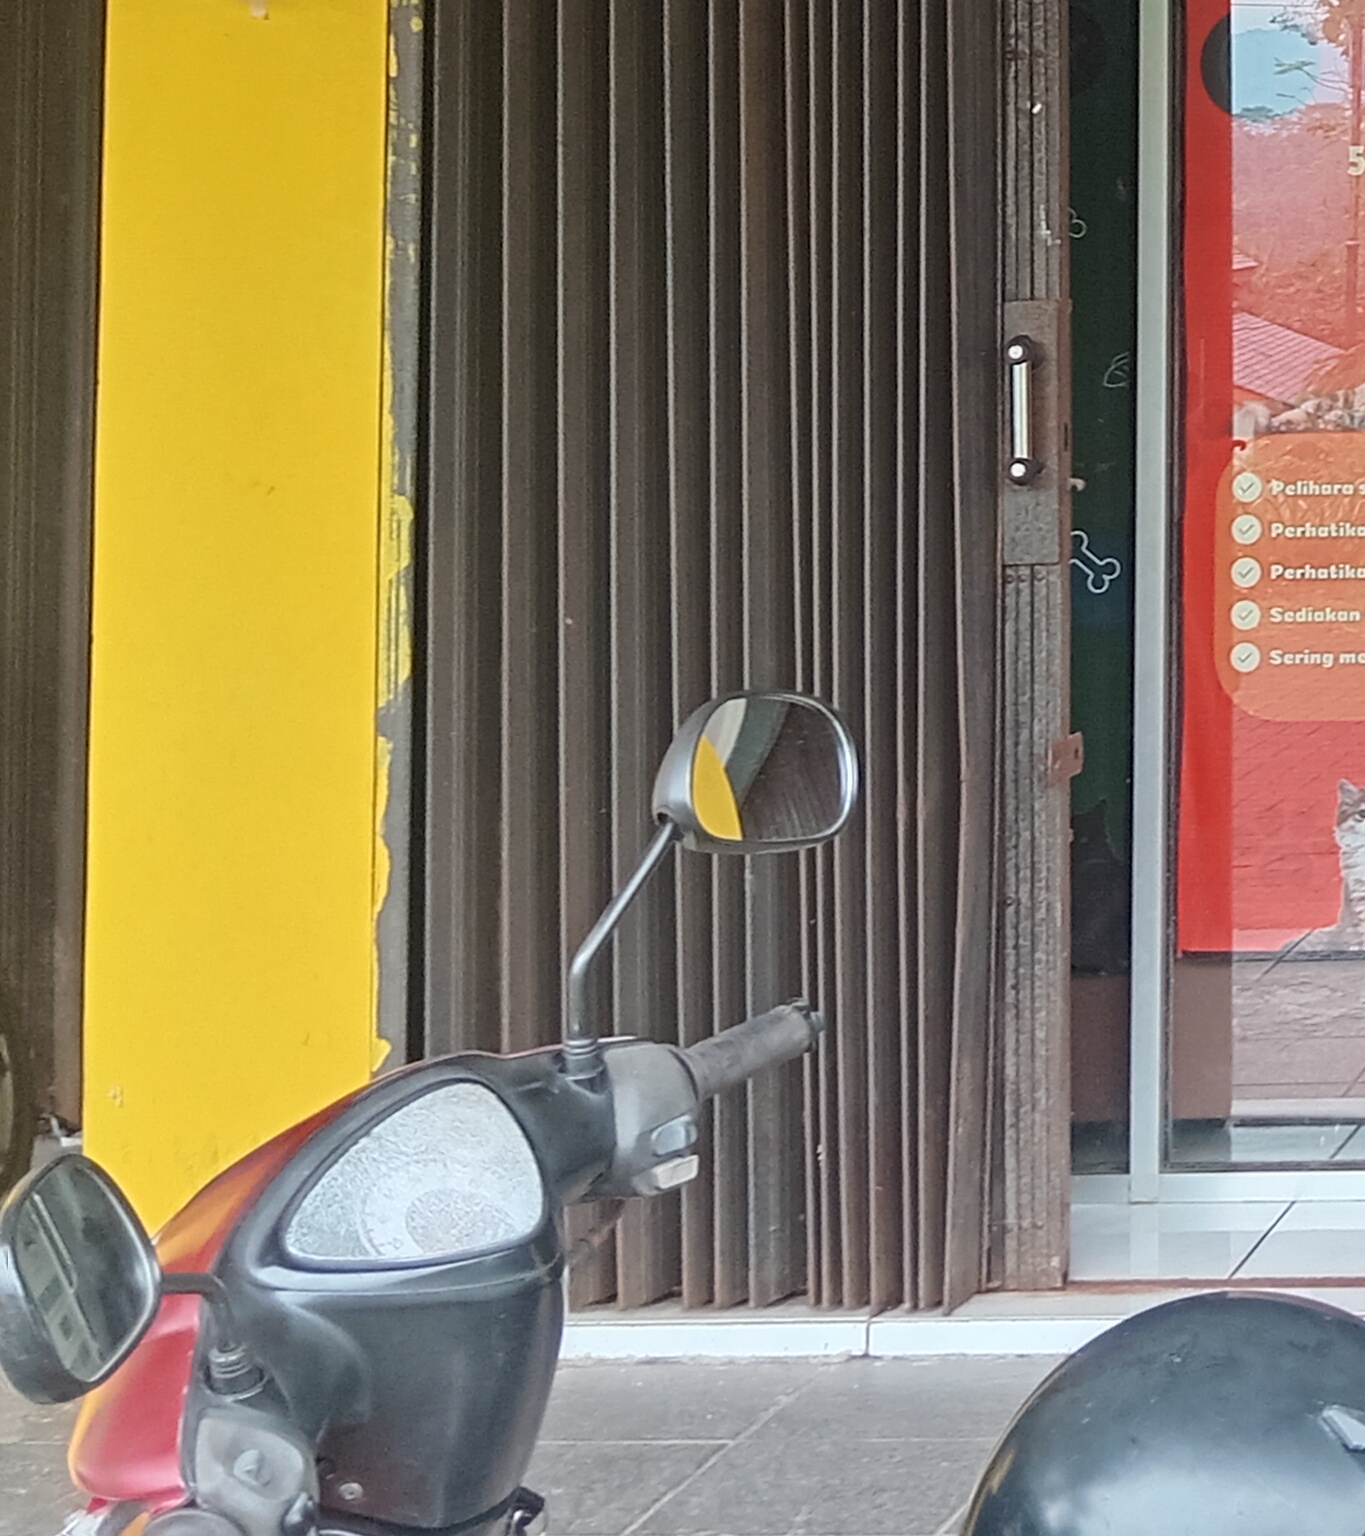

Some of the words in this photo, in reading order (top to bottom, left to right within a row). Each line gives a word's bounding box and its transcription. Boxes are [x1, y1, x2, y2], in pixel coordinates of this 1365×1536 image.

[1347, 145, 1365, 176] 5
[1271, 479, 1354, 496] Pelihara
[1269, 607, 1361, 622] Sediakan
[1269, 650, 1334, 668] Sering
